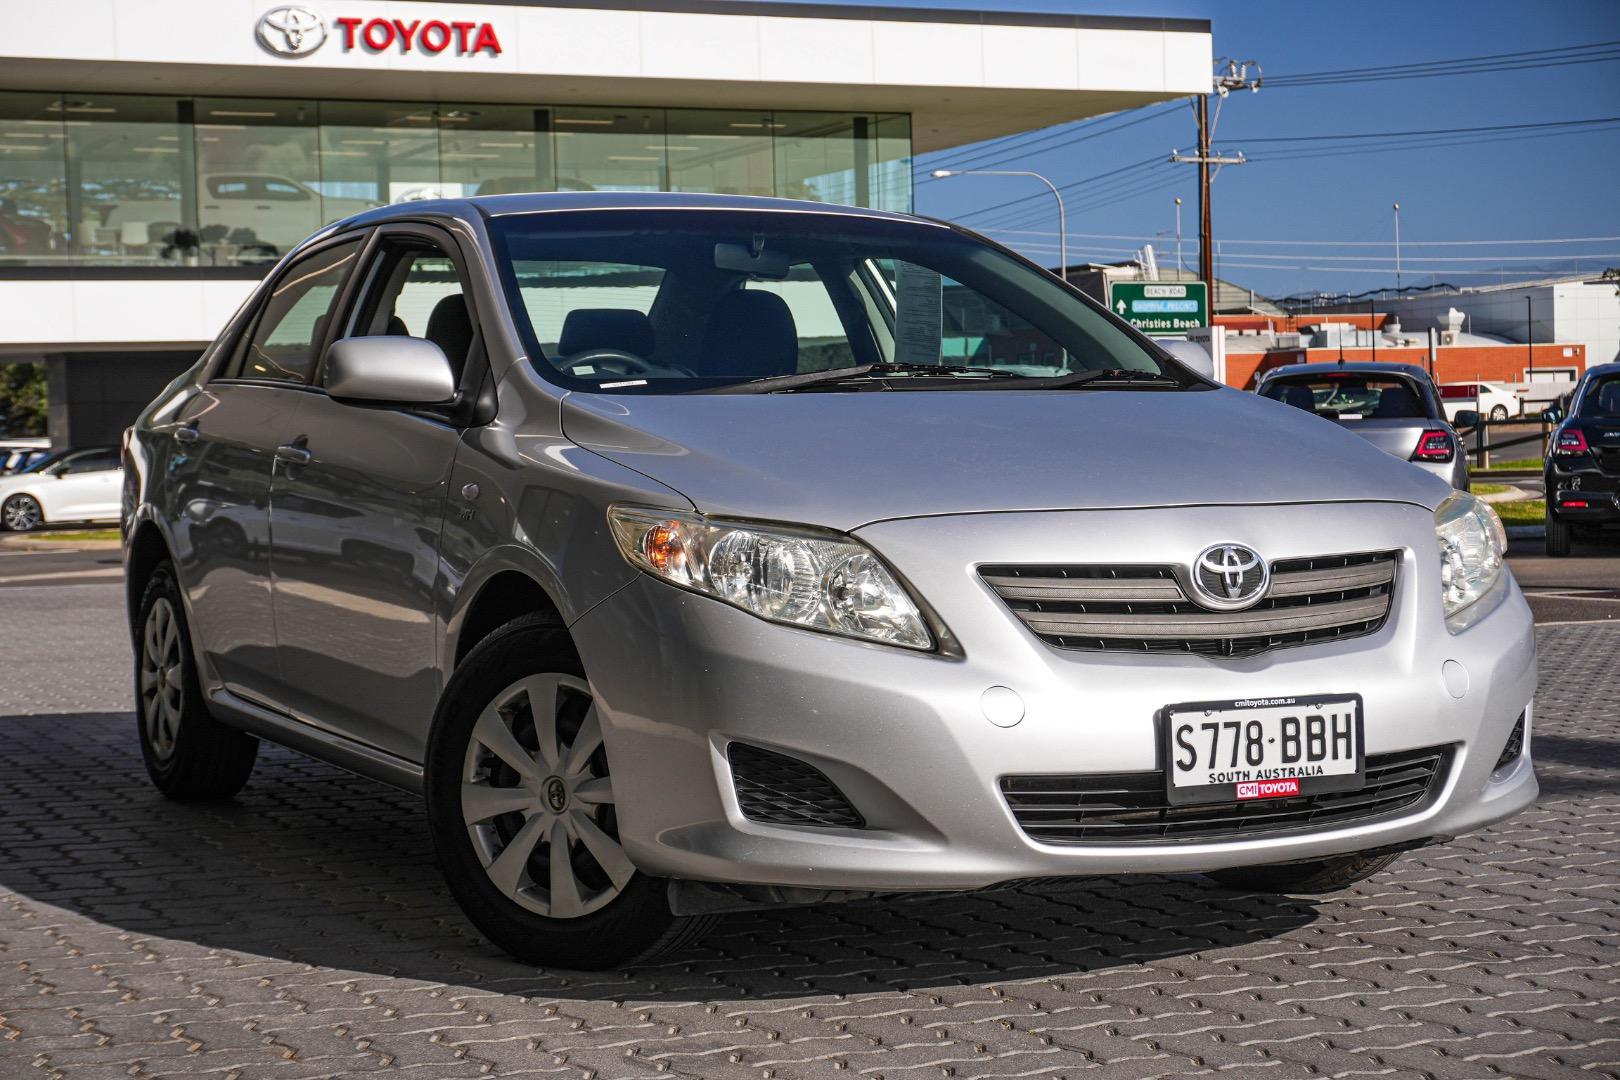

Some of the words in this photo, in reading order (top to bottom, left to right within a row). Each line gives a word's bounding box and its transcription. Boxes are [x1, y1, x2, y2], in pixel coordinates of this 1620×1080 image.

[336, 17, 502, 55] TOYOTA
[1146, 287, 1167, 295] BEACH
[1169, 287, 1185, 295] ROAD
[1130, 318, 1172, 329] Christies
[1173, 318, 1200, 328] Beach
[1234, 698, 1296, 708] cmitoyota.com.au
[1209, 770, 1251, 783] SOUTH
[1256, 765, 1324, 779] AUSTRALIA
[1238, 784, 1258, 797] CMI
[1259, 782, 1298, 794] TOYOTA
